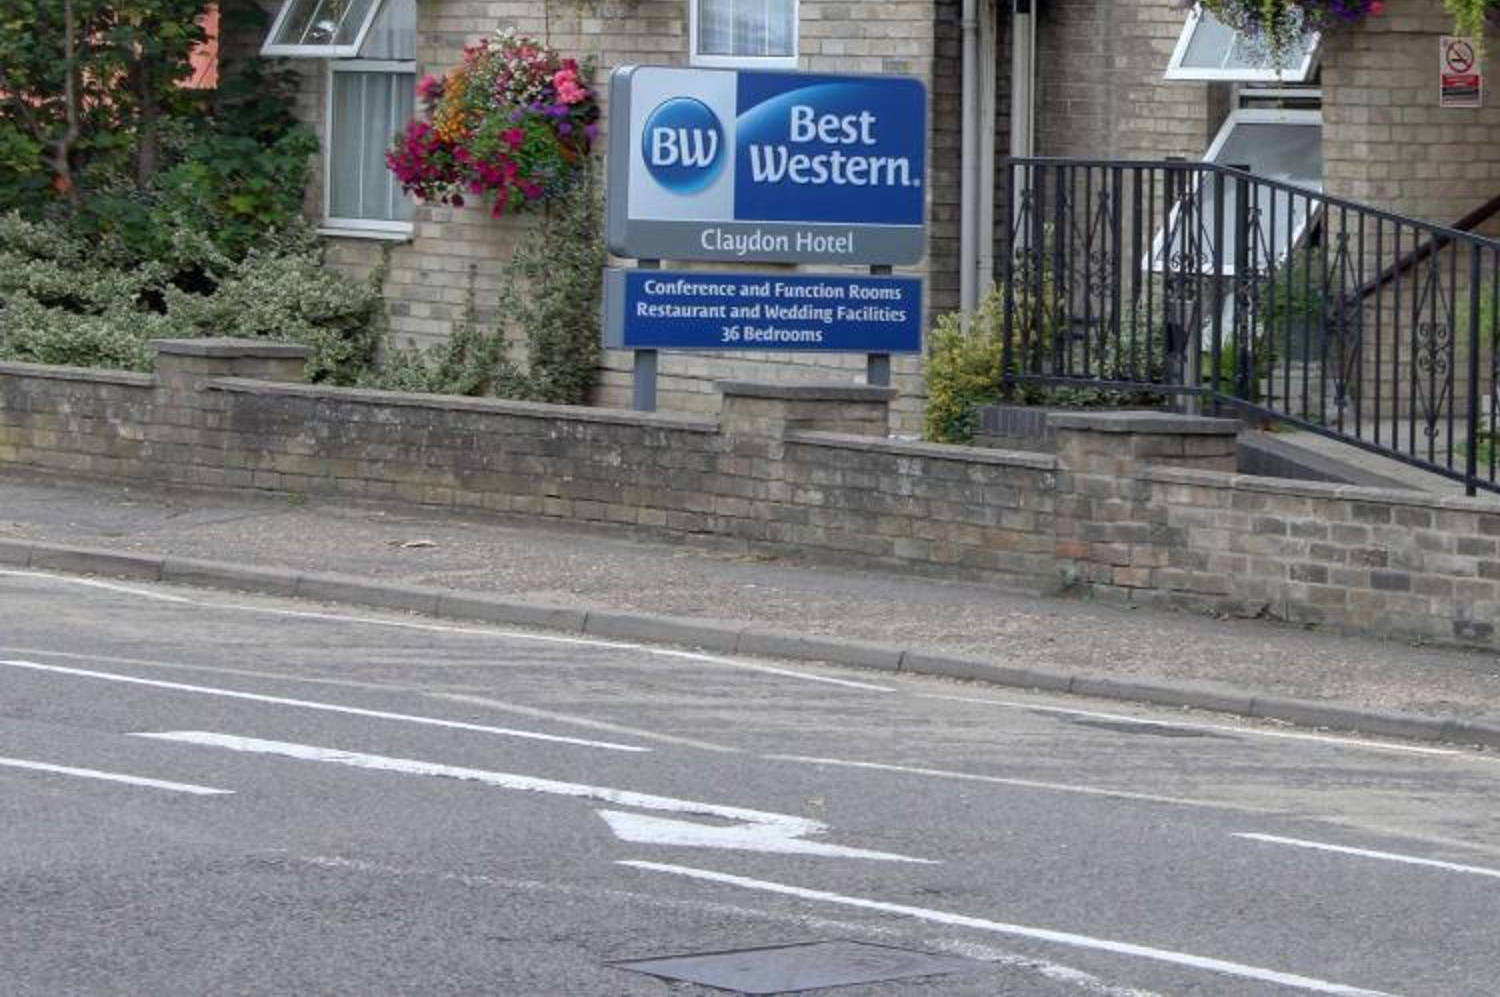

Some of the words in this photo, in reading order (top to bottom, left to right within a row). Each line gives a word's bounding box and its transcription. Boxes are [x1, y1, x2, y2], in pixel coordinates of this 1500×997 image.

[790, 105, 877, 145] Best
[651, 127, 719, 168] BW
[701, 228, 789, 255] Claydon
[795, 232, 854, 254] Hotel
[644, 280, 735, 299] Conference
[740, 282, 770, 298] and
[774, 283, 845, 300] Function
[849, 284, 902, 301] Rooms
[636, 302, 727, 319] Restaurant
[730, 305, 761, 320] and
[764, 304, 833, 324] Wedding
[837, 306, 907, 322] Facilities
[721, 326, 741, 342] 36
[744, 325, 824, 342] Bedrooms
